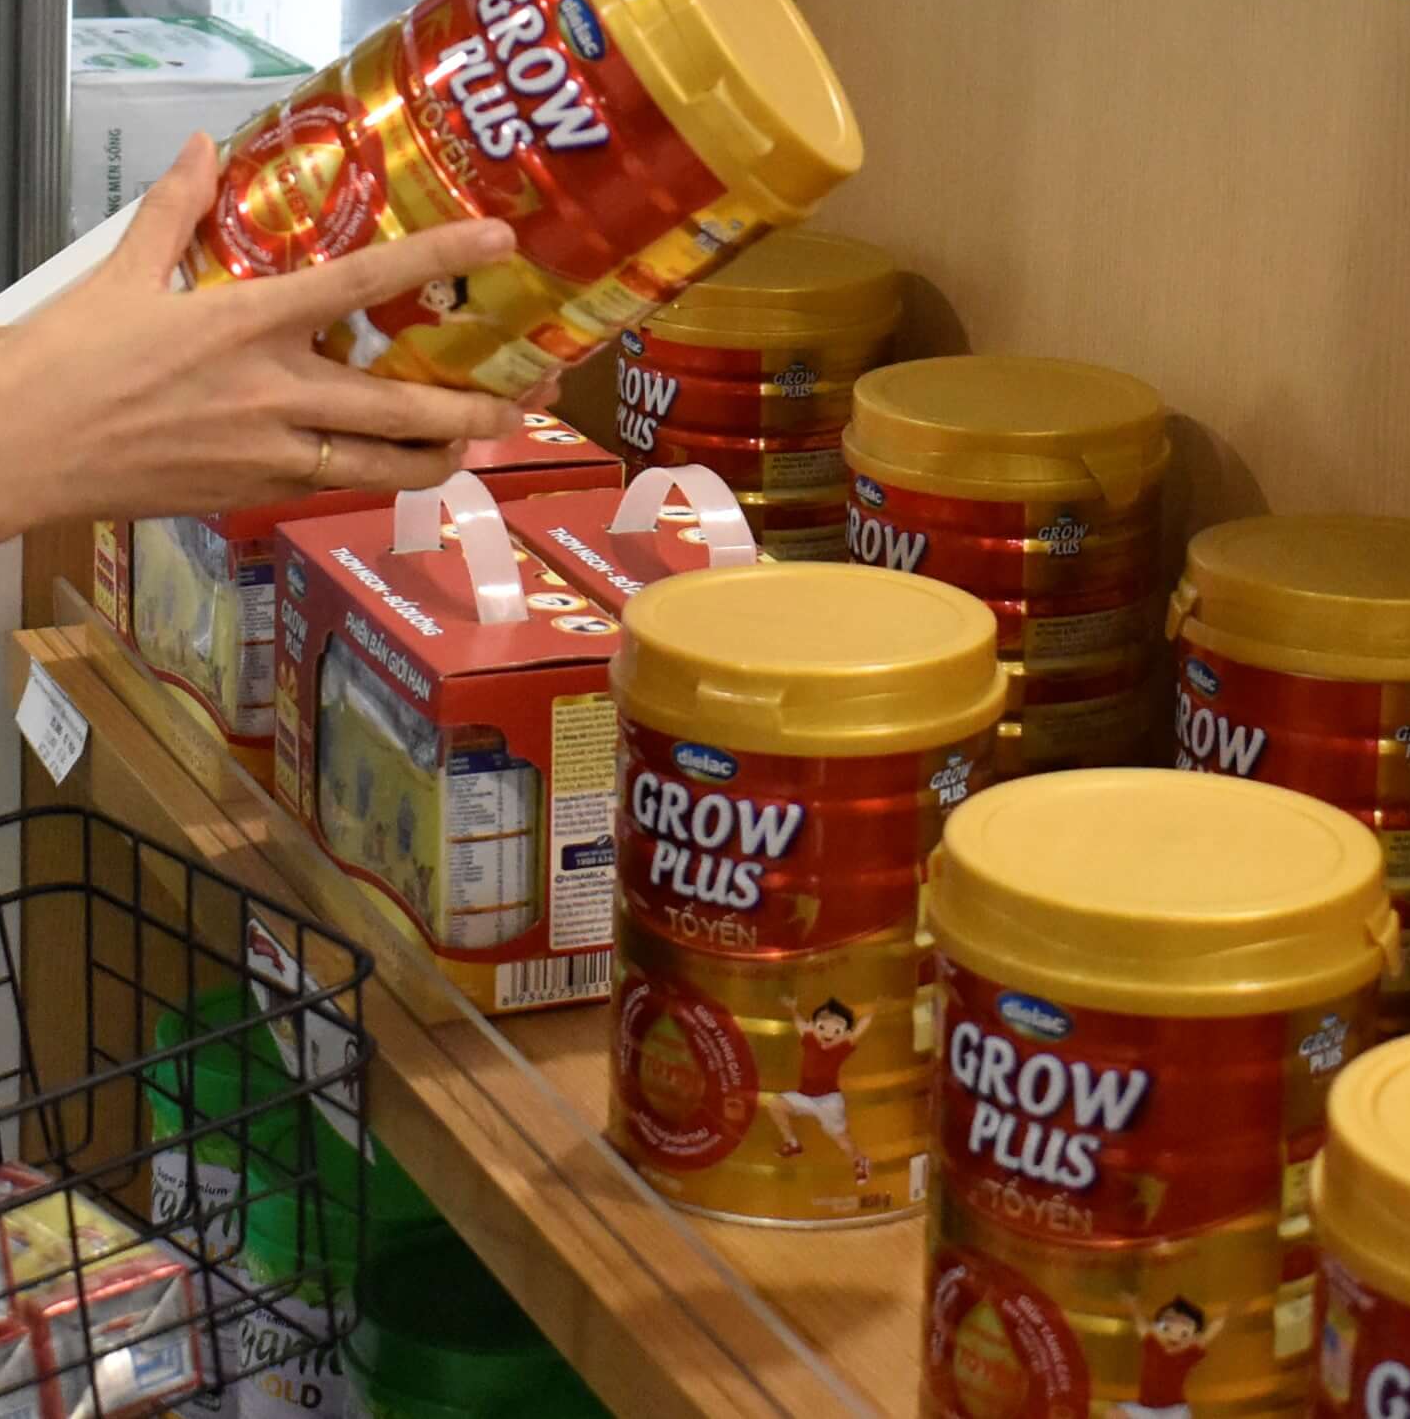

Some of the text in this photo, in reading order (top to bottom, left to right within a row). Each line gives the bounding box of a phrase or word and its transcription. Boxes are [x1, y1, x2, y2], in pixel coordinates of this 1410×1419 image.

[436, 35, 534, 160] PLUS
[617, 357, 677, 418] ROW
[1037, 521, 1089, 544] GROW
[1045, 537, 1082, 557] PLUS
[344, 611, 370, 649] PHIÊN
[368, 632, 390, 666] BẢN
[406, 667, 432, 702] HẠN
[675, 745, 735, 778] dielac
[1176, 685, 1268, 776] ROW
[632, 772, 803, 861] GROW
[938, 782, 968, 807] PLUS
[650, 840, 765, 910] PLUS
[698, 907, 758, 949] YẾN
[950, 1021, 1149, 1132] GROW
[967, 1101, 1102, 1190] PLUS
